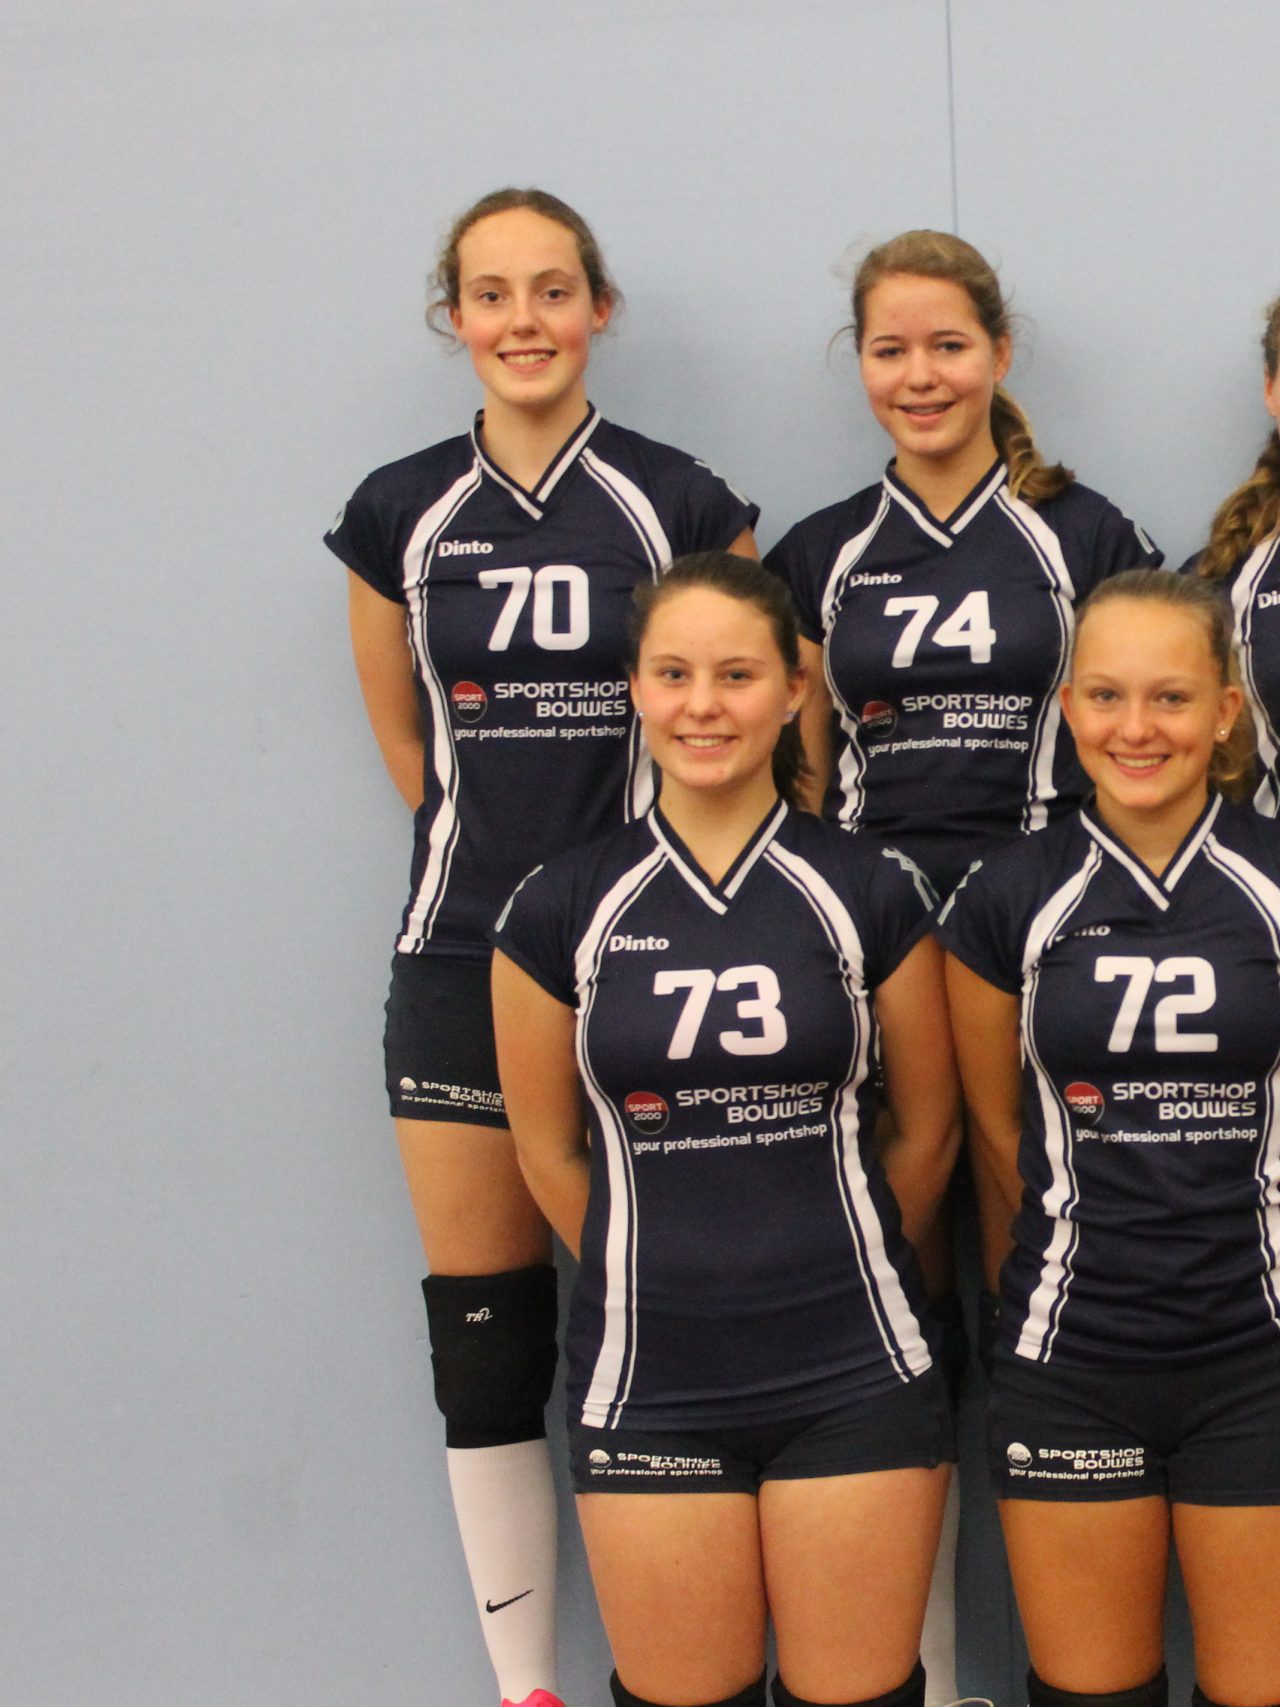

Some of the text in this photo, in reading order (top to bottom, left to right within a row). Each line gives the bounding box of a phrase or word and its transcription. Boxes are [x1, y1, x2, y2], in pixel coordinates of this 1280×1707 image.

[439, 541, 493, 557] Dinto
[850, 572, 902, 587] Dinto
[478, 565, 589, 651] 70
[884, 590, 996, 668] 74
[454, 693, 482, 701] SPORT
[494, 681, 628, 698] SPORTSHOP
[536, 700, 626, 717] BOUWES
[902, 694, 1032, 712] SPORTSHOP
[944, 713, 1028, 730] BOUWES
[454, 726, 626, 740] your professional sportshop
[868, 737, 1028, 758] your professional sportshop
[610, 936, 669, 952] Dinto
[654, 964, 787, 1060] 73
[1094, 956, 1218, 1053] 72
[422, 1082, 502, 1100] SPORTSHO
[450, 1092, 502, 1106] BOUWE
[676, 1082, 829, 1106] SPORTSHOP
[1112, 1082, 1256, 1100] SPORTSHOP
[628, 1102, 662, 1112] SPORT
[727, 1097, 823, 1124] BOUWES
[1159, 1102, 1256, 1120] BOUWES
[634, 1112, 661, 1120] 2000
[634, 1124, 827, 1154] your professional sportshop
[1186, 1128, 1257, 1144] sportshop
[1038, 1448, 1144, 1460] SPORTSHOP
[608, 1468, 666, 1476] professional
[1074, 1457, 1144, 1470] BOUWES
[1010, 1468, 1144, 1480] your professional sportshop
